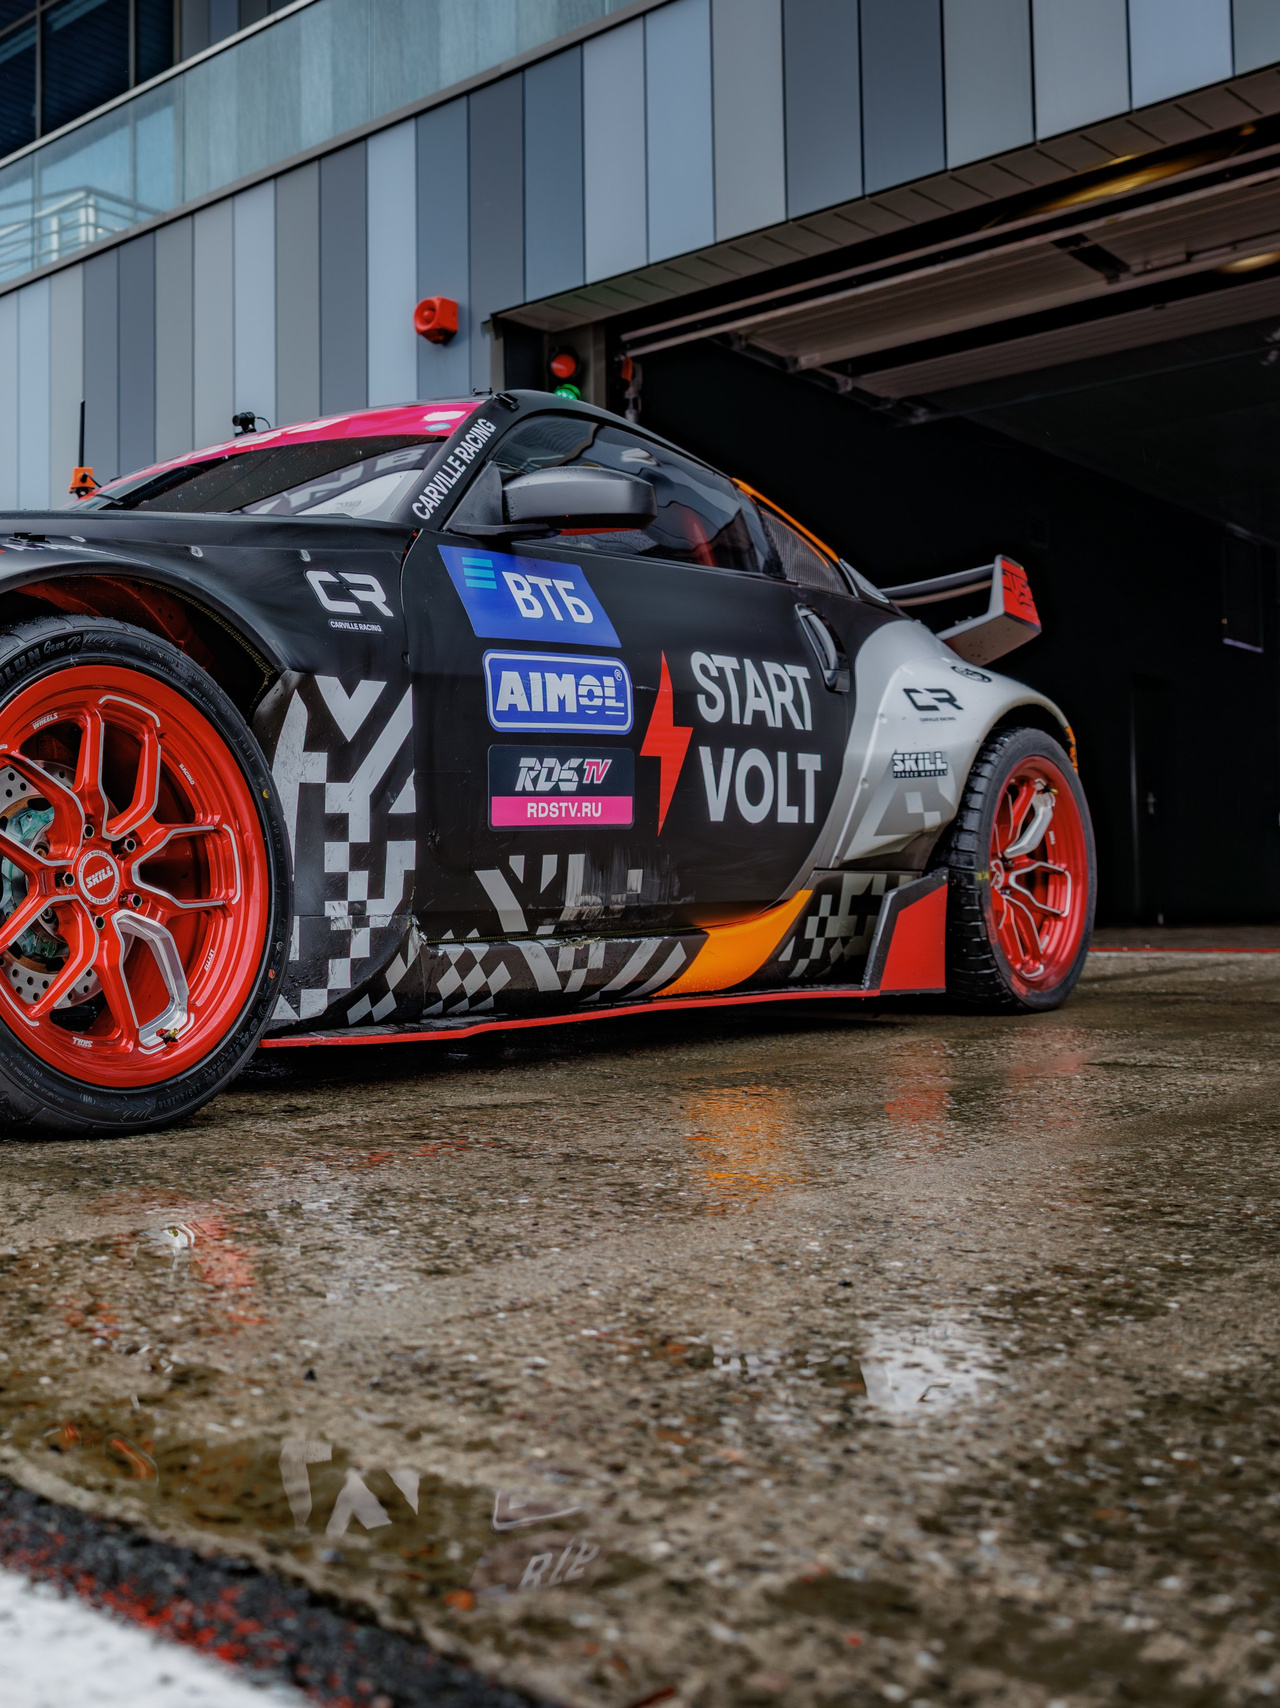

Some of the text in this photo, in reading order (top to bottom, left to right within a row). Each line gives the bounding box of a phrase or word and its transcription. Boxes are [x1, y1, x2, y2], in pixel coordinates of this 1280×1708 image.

[412, 455, 467, 520] CARVILLE
[454, 418, 496, 464] RACING
[501, 571, 594, 624] ВТБ
[330, 621, 382, 632] CARVILLE RACING
[496, 671, 625, 715] AIMOL
[690, 651, 813, 731] START
[32, 712, 58, 730] WHEELS
[893, 752, 947, 771] SKILL
[699, 746, 821, 823] VOLT
[527, 802, 602, 818] RDSTV.RU
[85, 866, 114, 889] SKILL
